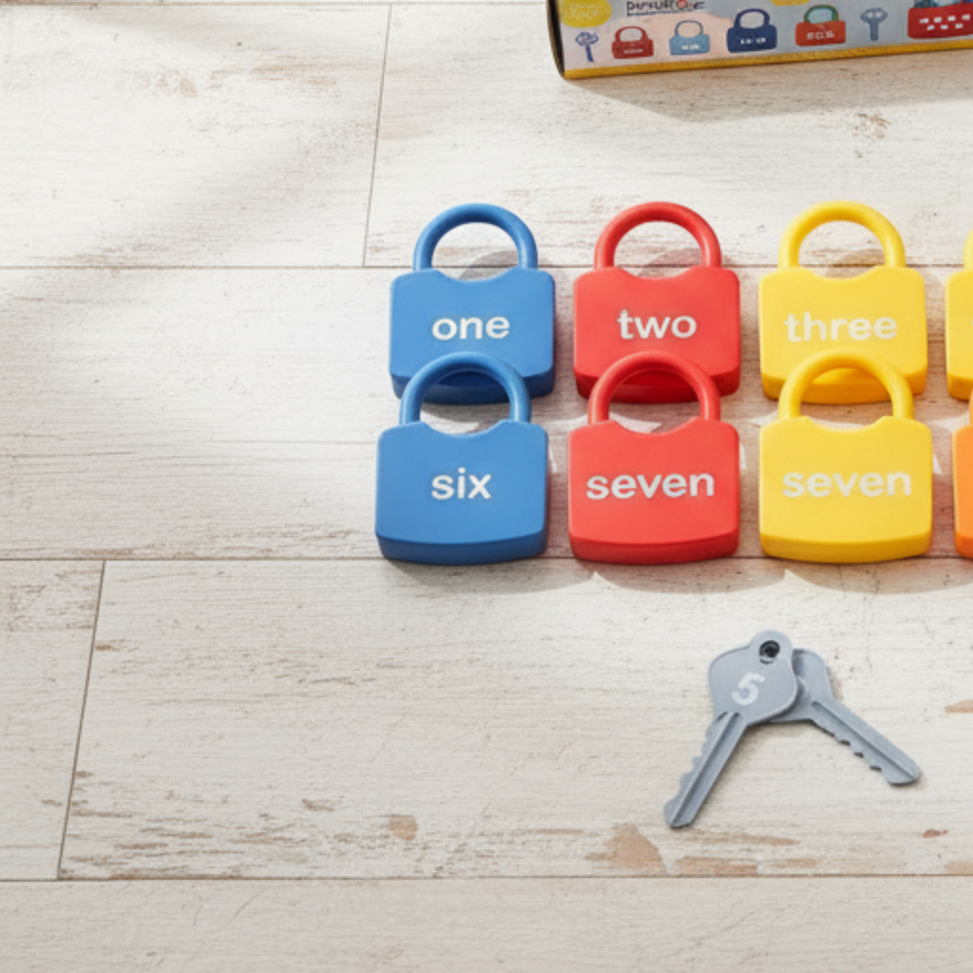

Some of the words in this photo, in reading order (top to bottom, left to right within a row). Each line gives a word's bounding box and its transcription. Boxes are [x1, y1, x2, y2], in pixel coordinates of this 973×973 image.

[432, 313, 511, 340] one
[617, 309, 697, 339] two
[784, 312, 898, 342] three
[431, 467, 492, 500] six
[586, 471, 715, 500] seven
[782, 469, 912, 498] seven
[731, 672, 766, 706] 5
